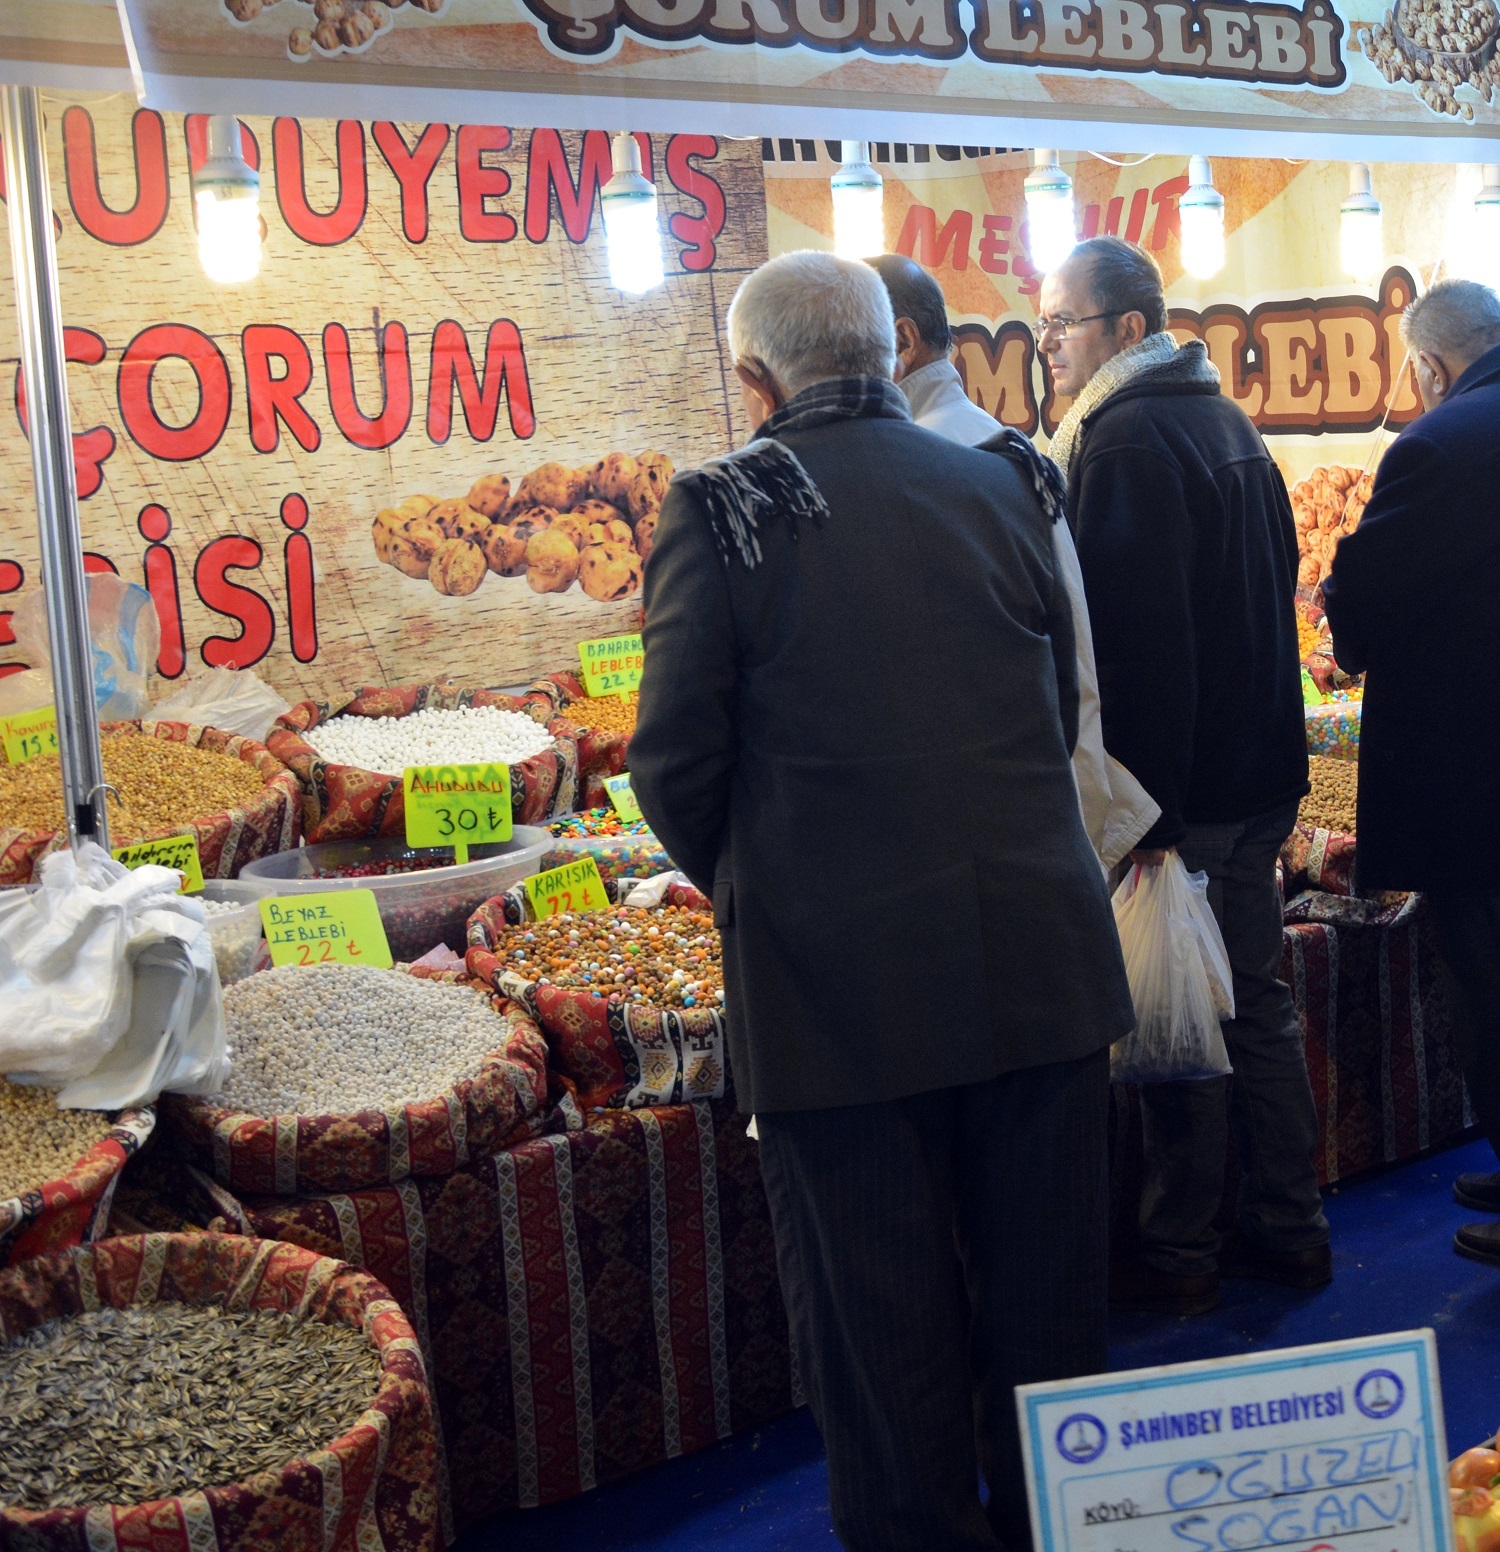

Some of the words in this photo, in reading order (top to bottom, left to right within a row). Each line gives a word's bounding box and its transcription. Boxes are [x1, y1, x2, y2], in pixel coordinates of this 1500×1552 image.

[984, 0, 1337, 76] LEBLEBİ
[15, 318, 536, 499] ÇORUM
[591, 656, 643, 675] LEBLEB
[601, 674, 625, 689] 22
[435, 808, 478, 836] 30
[269, 903, 334, 925] BEYAZ
[297, 940, 337, 967] 22
[1119, 1408, 1223, 1449] ŞAHİNBEY
[1230, 1386, 1345, 1430] BELEDİYESİ
